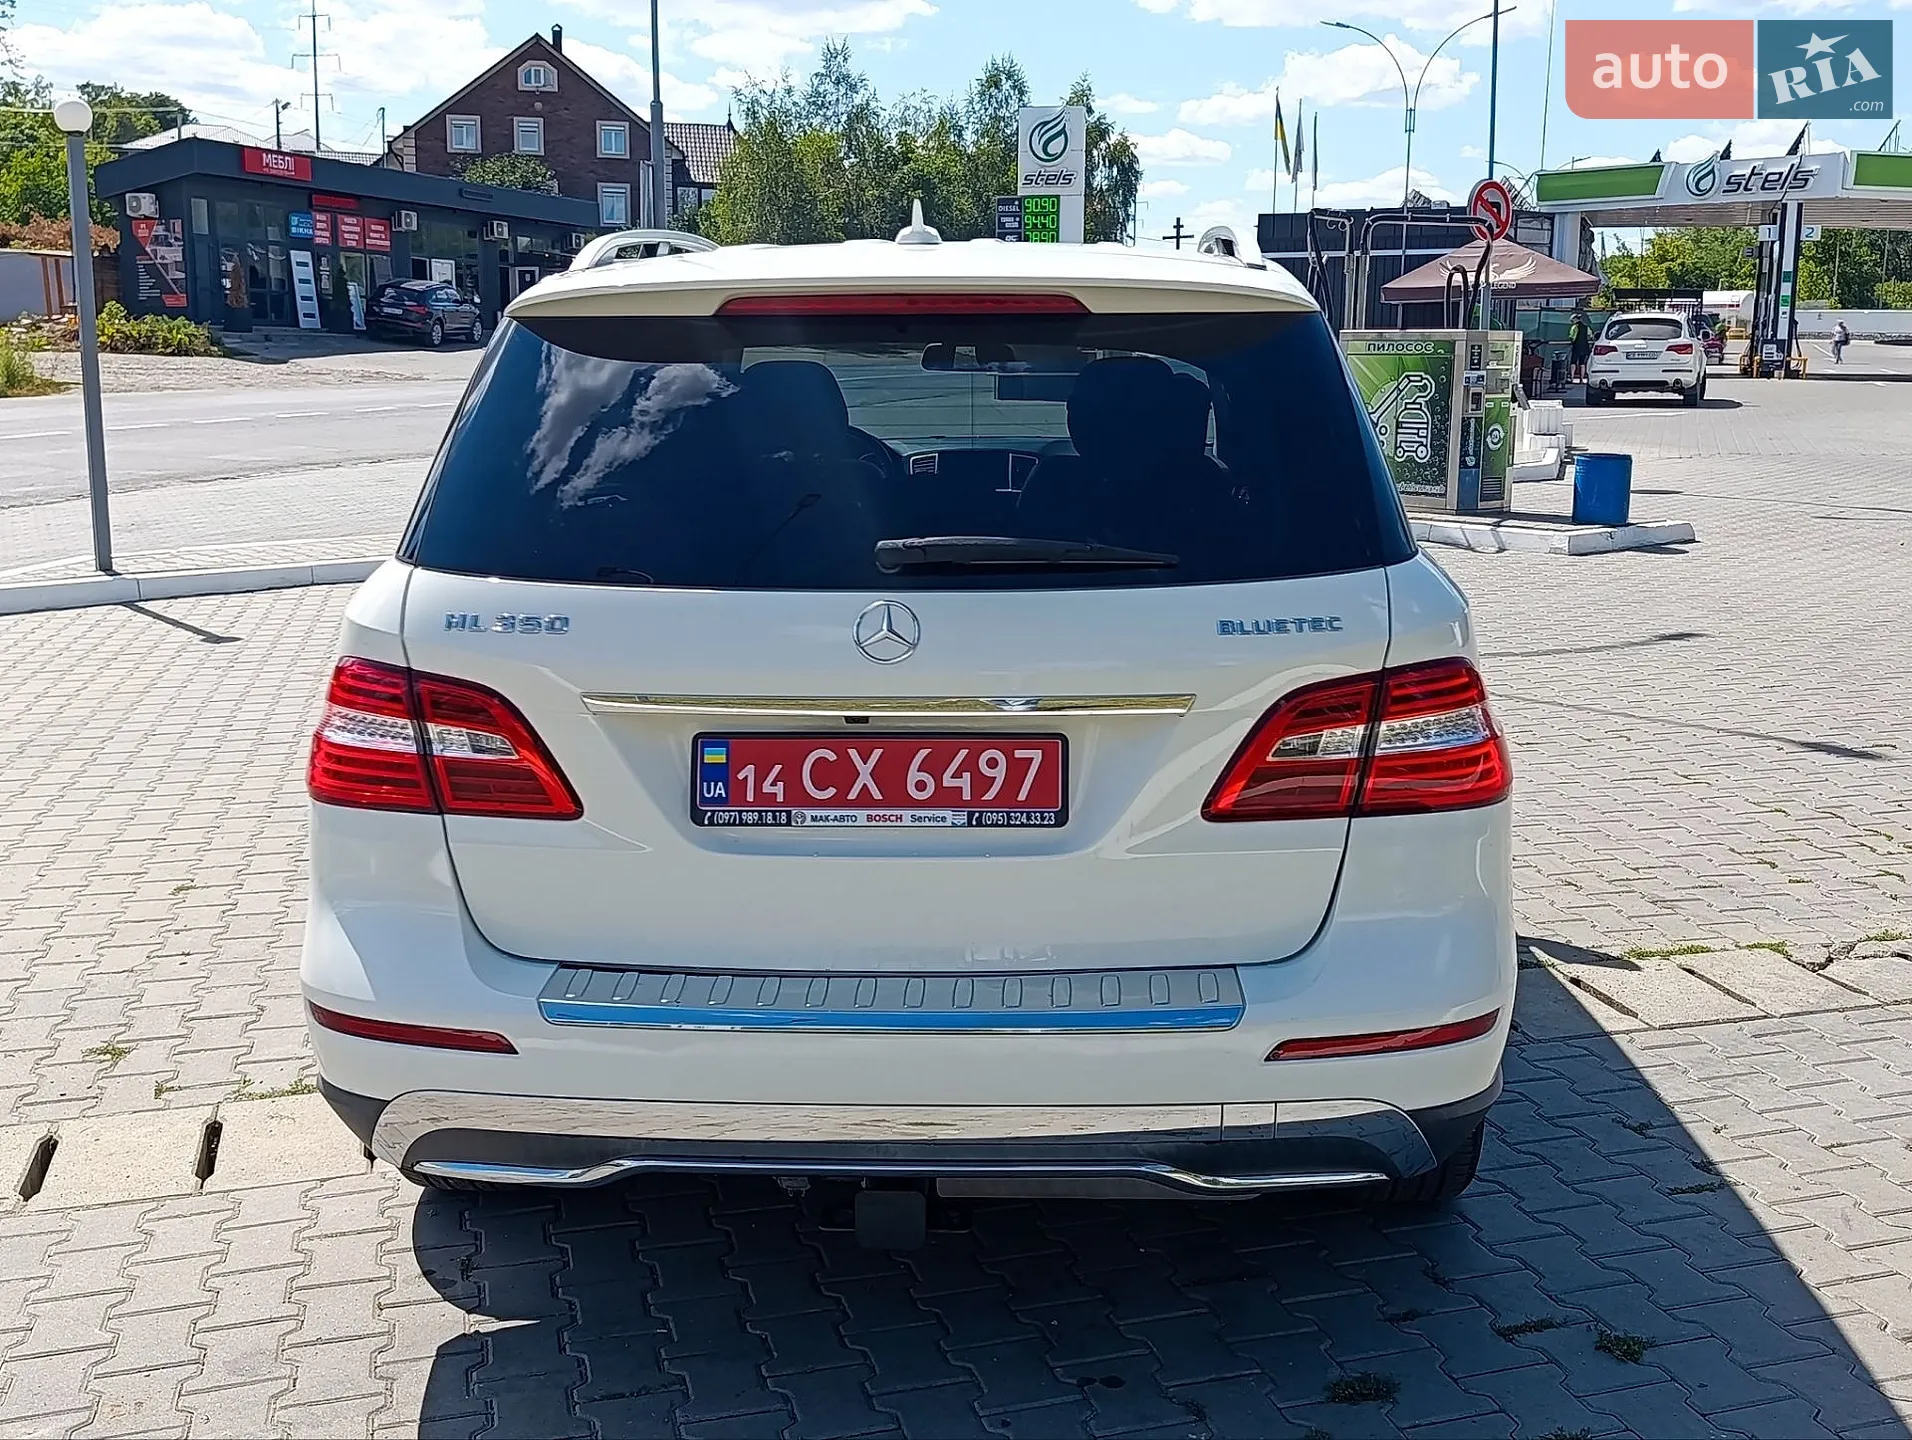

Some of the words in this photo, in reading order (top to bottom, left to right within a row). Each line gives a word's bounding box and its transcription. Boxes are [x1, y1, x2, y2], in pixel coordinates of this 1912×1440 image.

[262, 152, 295, 171] МЕБЛІ
[1021, 169, 1075, 186] stels
[1721, 162, 1817, 194] stels
[1766, 227, 1772, 239] 1
[1805, 227, 1815, 238] 2
[1367, 342, 1434, 353] ПИЛОСОС
[491, 612, 570, 634] 350
[1216, 616, 1343, 636] BLUETEC
[736, 764, 784, 802] 14
[801, 748, 885, 801] CX
[906, 748, 1043, 801] 6497
[703, 781, 726, 798] UA
[714, 811, 739, 825] (097)
[741, 811, 787, 824] 989.18.18
[866, 814, 903, 823] BOSCH
[910, 814, 947, 823] Service
[982, 811, 1008, 825] (095)
[1009, 812, 1056, 825] 324.33.23
